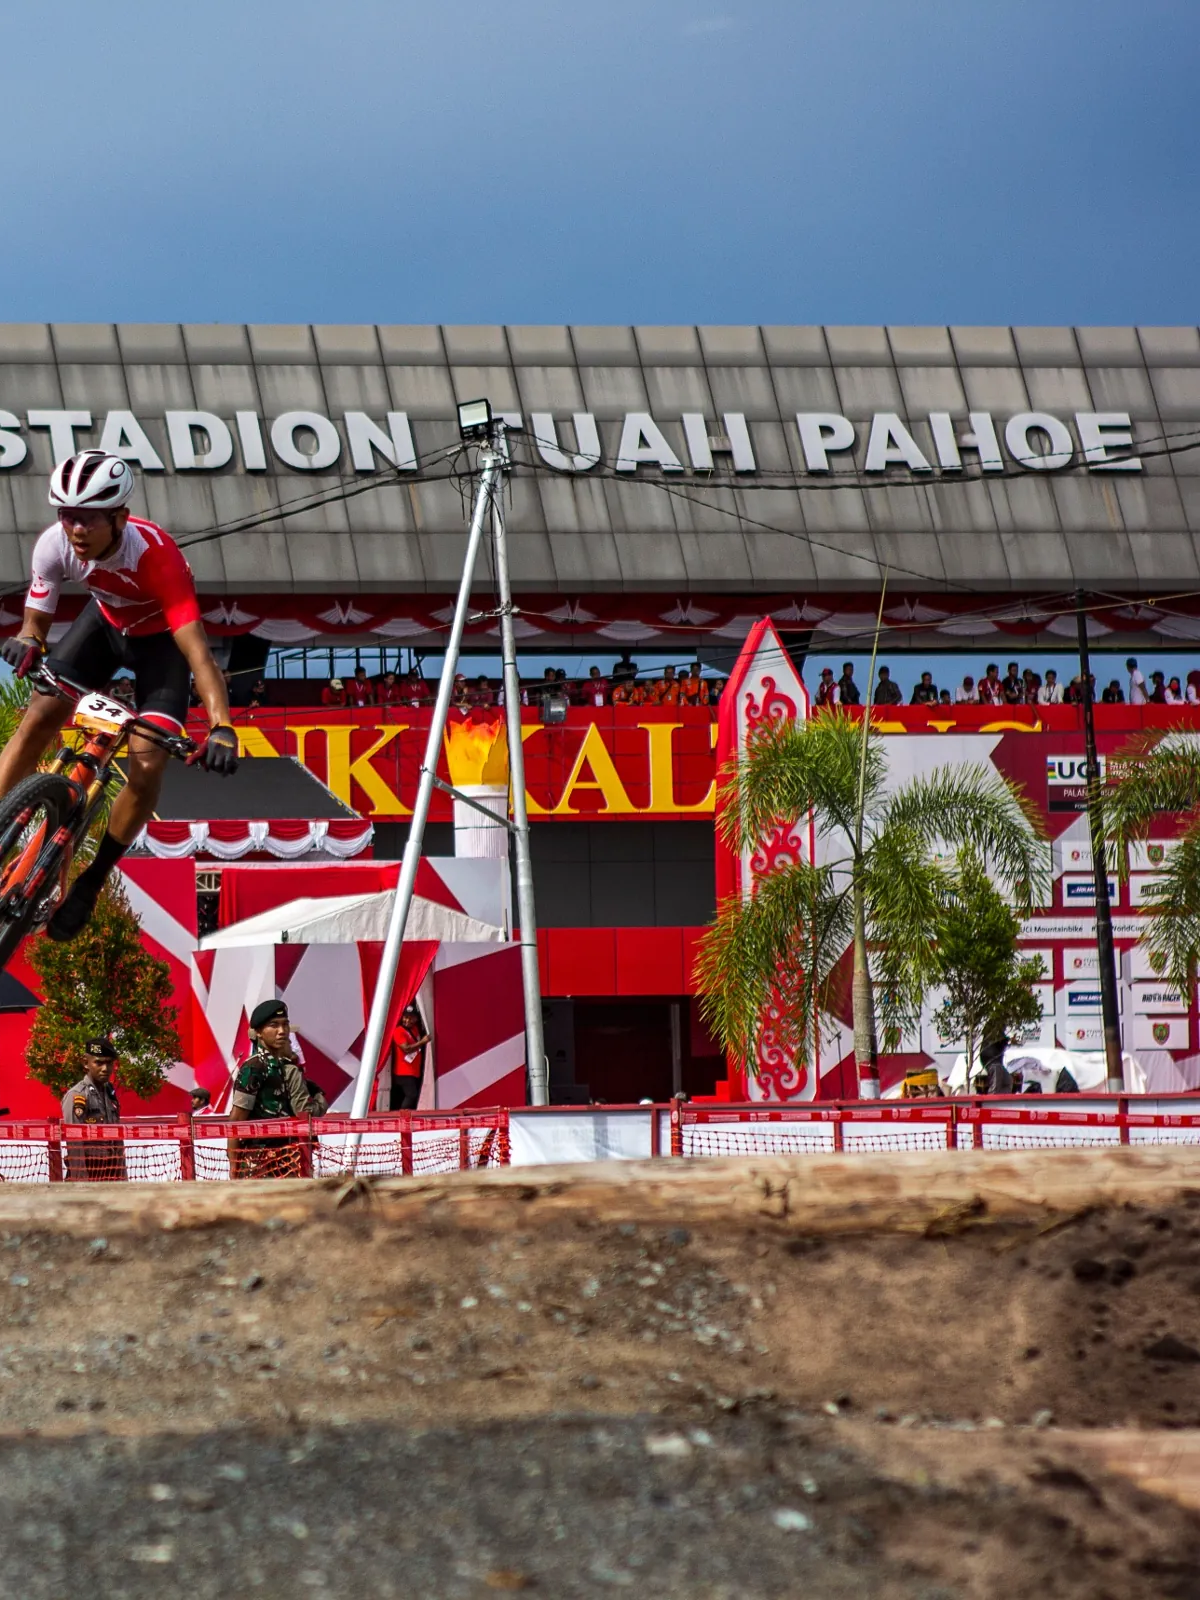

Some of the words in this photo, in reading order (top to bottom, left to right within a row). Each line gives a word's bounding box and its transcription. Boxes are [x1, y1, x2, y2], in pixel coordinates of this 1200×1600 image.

[796, 411, 1142, 473] PAHOE
[88, 699, 122, 717] 34
[1057, 761, 1101, 779] UC
